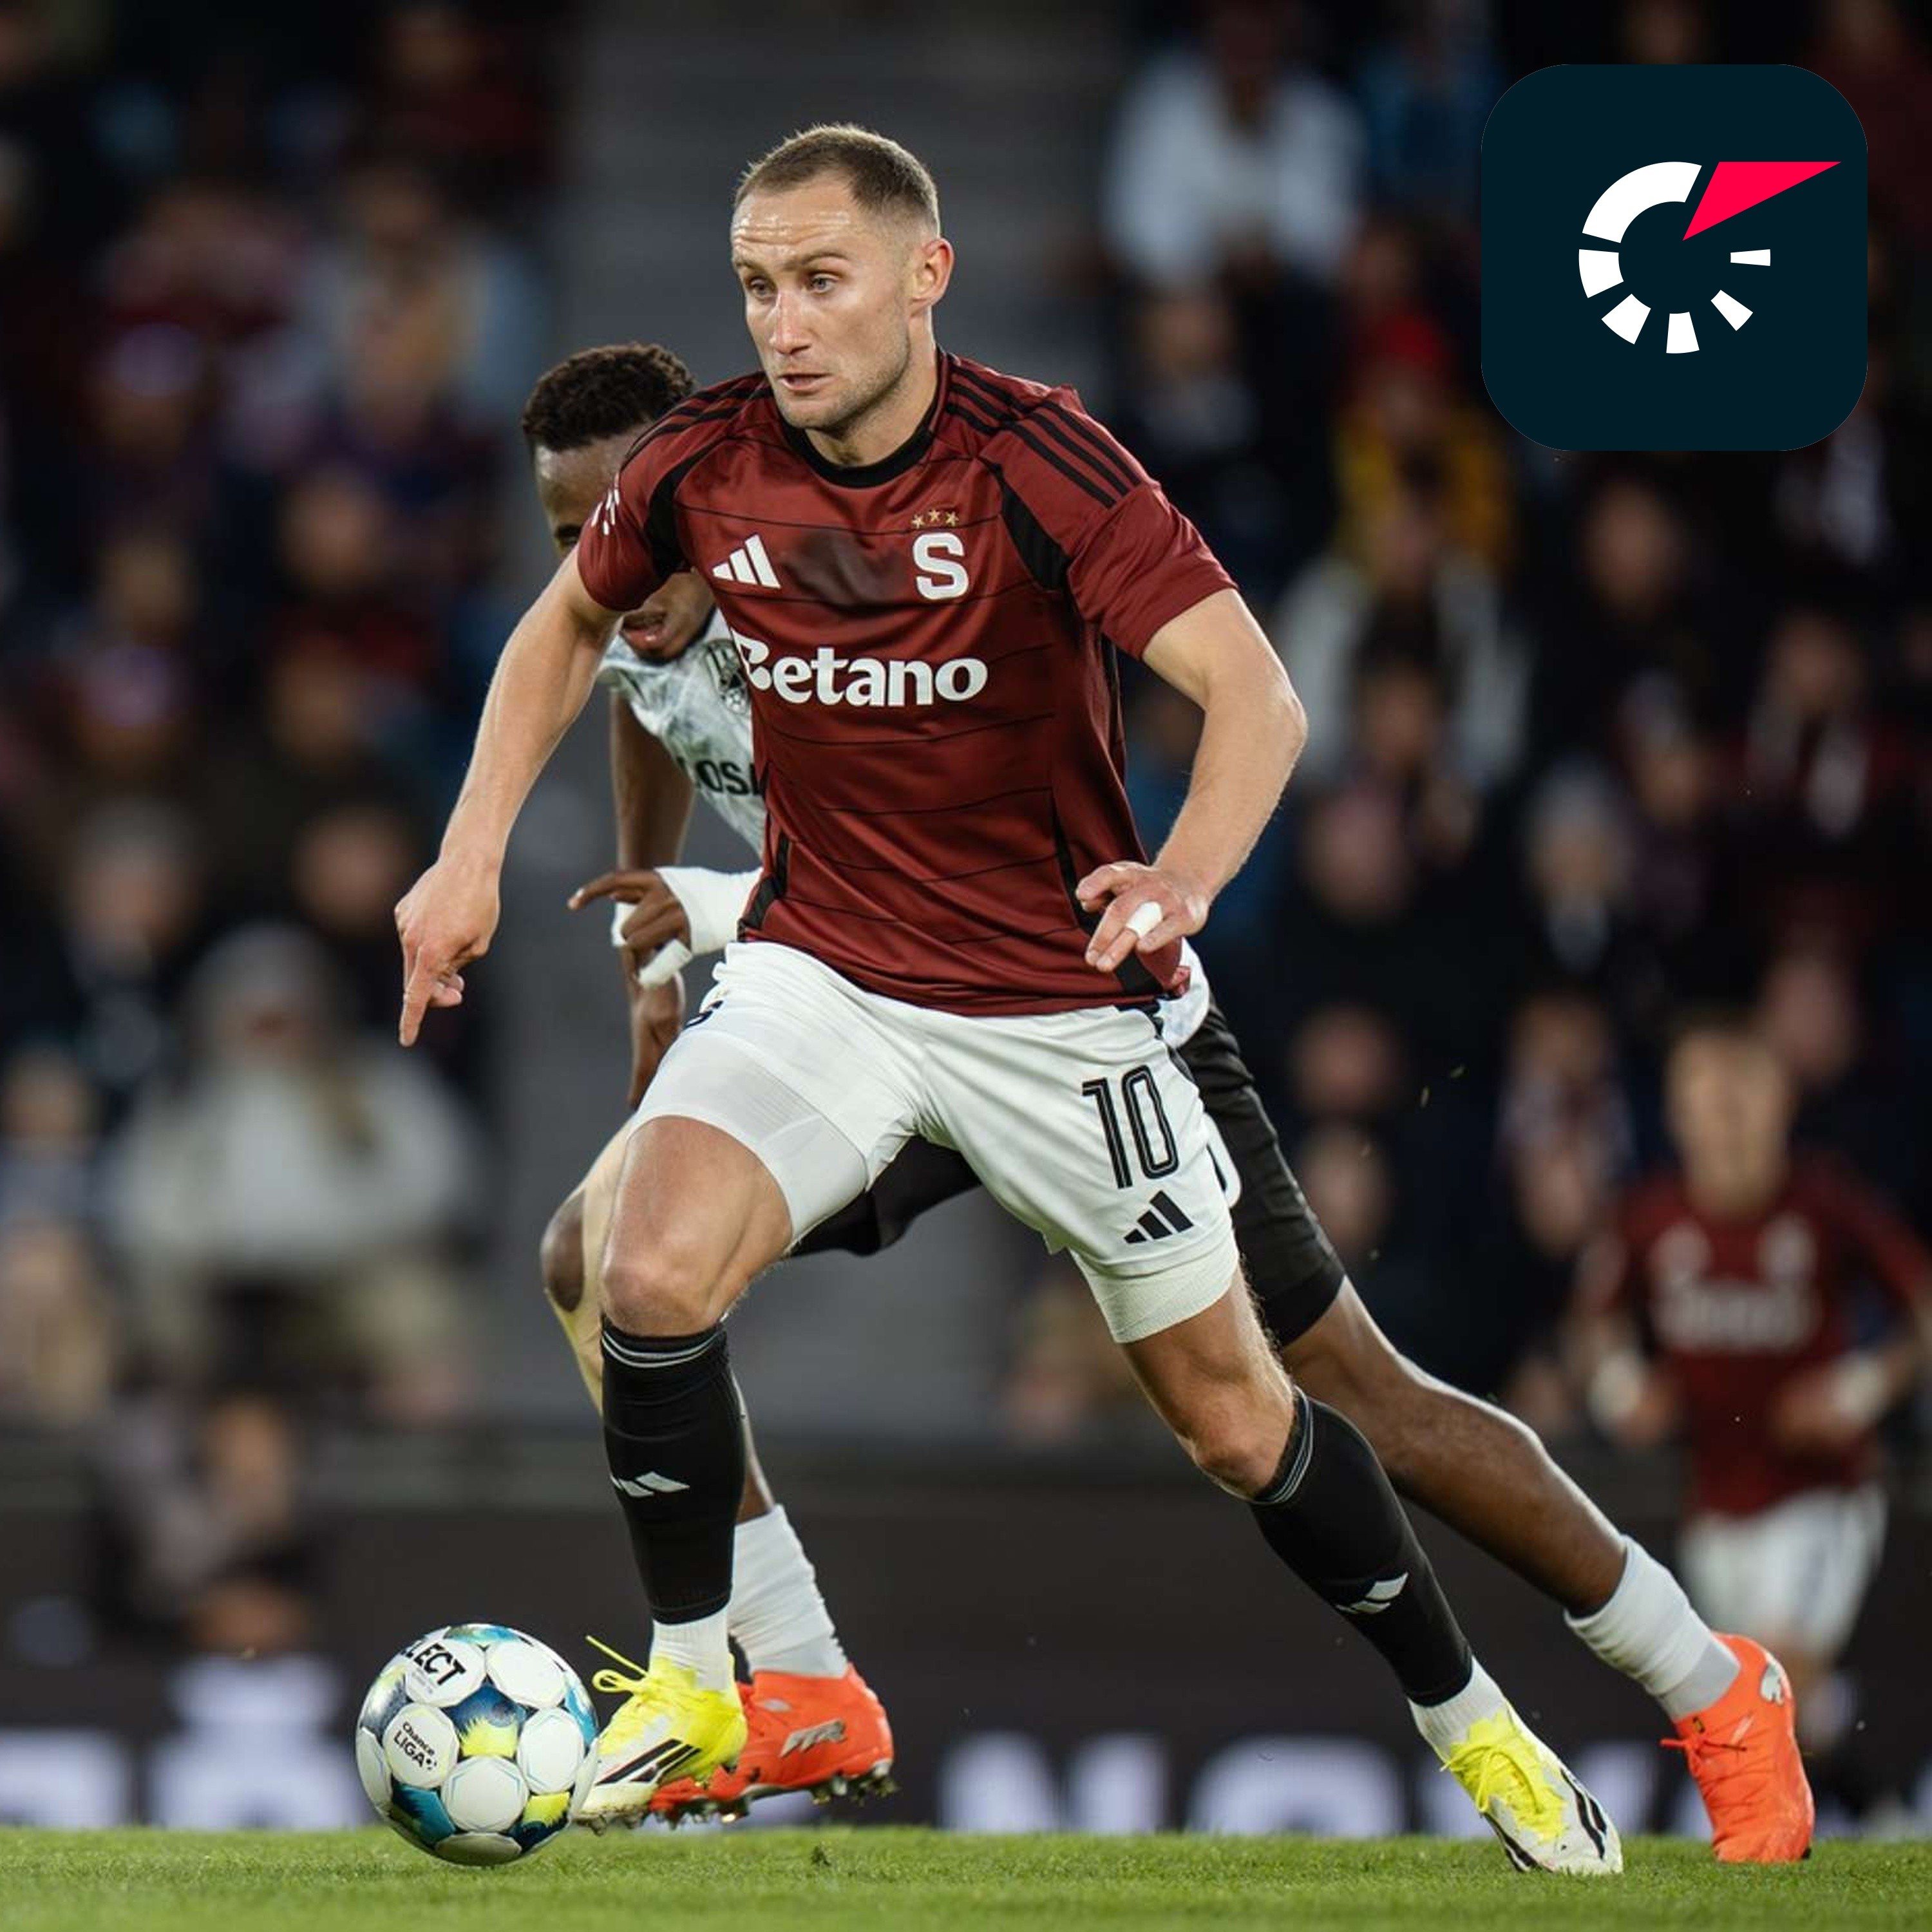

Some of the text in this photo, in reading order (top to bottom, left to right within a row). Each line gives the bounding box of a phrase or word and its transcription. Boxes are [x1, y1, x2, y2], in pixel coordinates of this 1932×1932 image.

[912, 531, 969, 600] S
[1082, 1065, 1179, 1189] 10
[402, 1641, 467, 1686] LECT
[393, 1730, 425, 1768] LIGA
